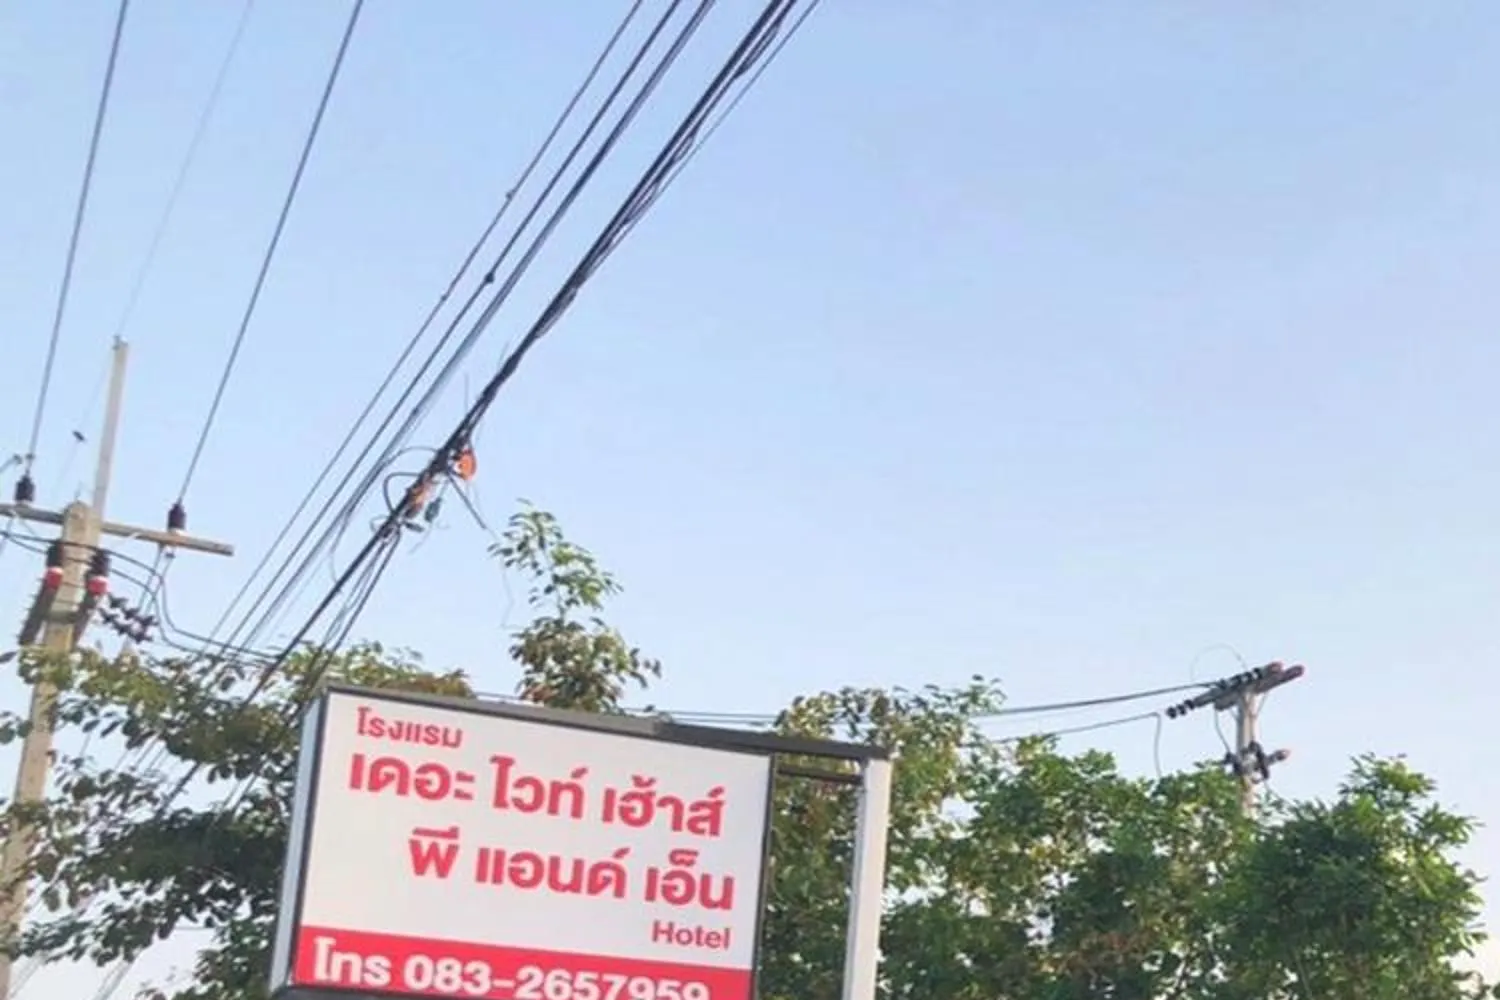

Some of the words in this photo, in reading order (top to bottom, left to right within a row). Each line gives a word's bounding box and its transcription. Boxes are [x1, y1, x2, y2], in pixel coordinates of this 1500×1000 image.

[356, 705, 464, 749] โรงแรม
[348, 752, 475, 802] เดอะ
[490, 754, 590, 820] ไวท์
[600, 774, 726, 838] เฮ้าส์
[408, 825, 461, 880] พี
[473, 846, 632, 900] แอนด์
[643, 848, 736, 911] เอ็น
[651, 920, 732, 950] Hotel
[315, 937, 392, 987] โทร
